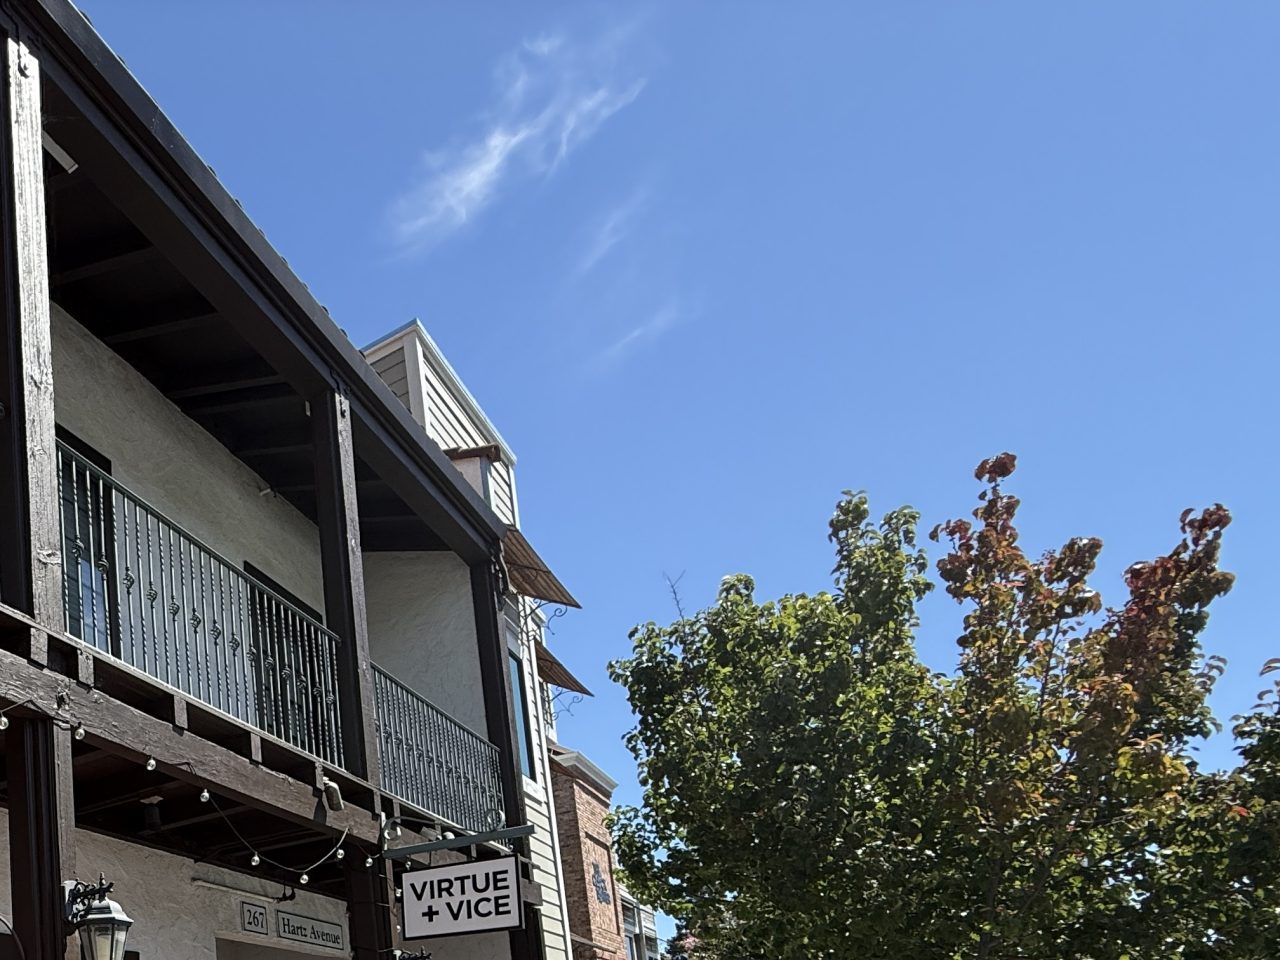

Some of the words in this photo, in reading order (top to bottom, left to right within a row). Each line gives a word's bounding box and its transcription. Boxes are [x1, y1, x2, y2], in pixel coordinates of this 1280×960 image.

[409, 869, 510, 902] VIRTUE
[246, 909, 265, 929] 267
[422, 905, 439, 922] +
[445, 894, 511, 921] VICE
[282, 917, 308, 937] Hartz
[309, 925, 341, 945] Avenue
